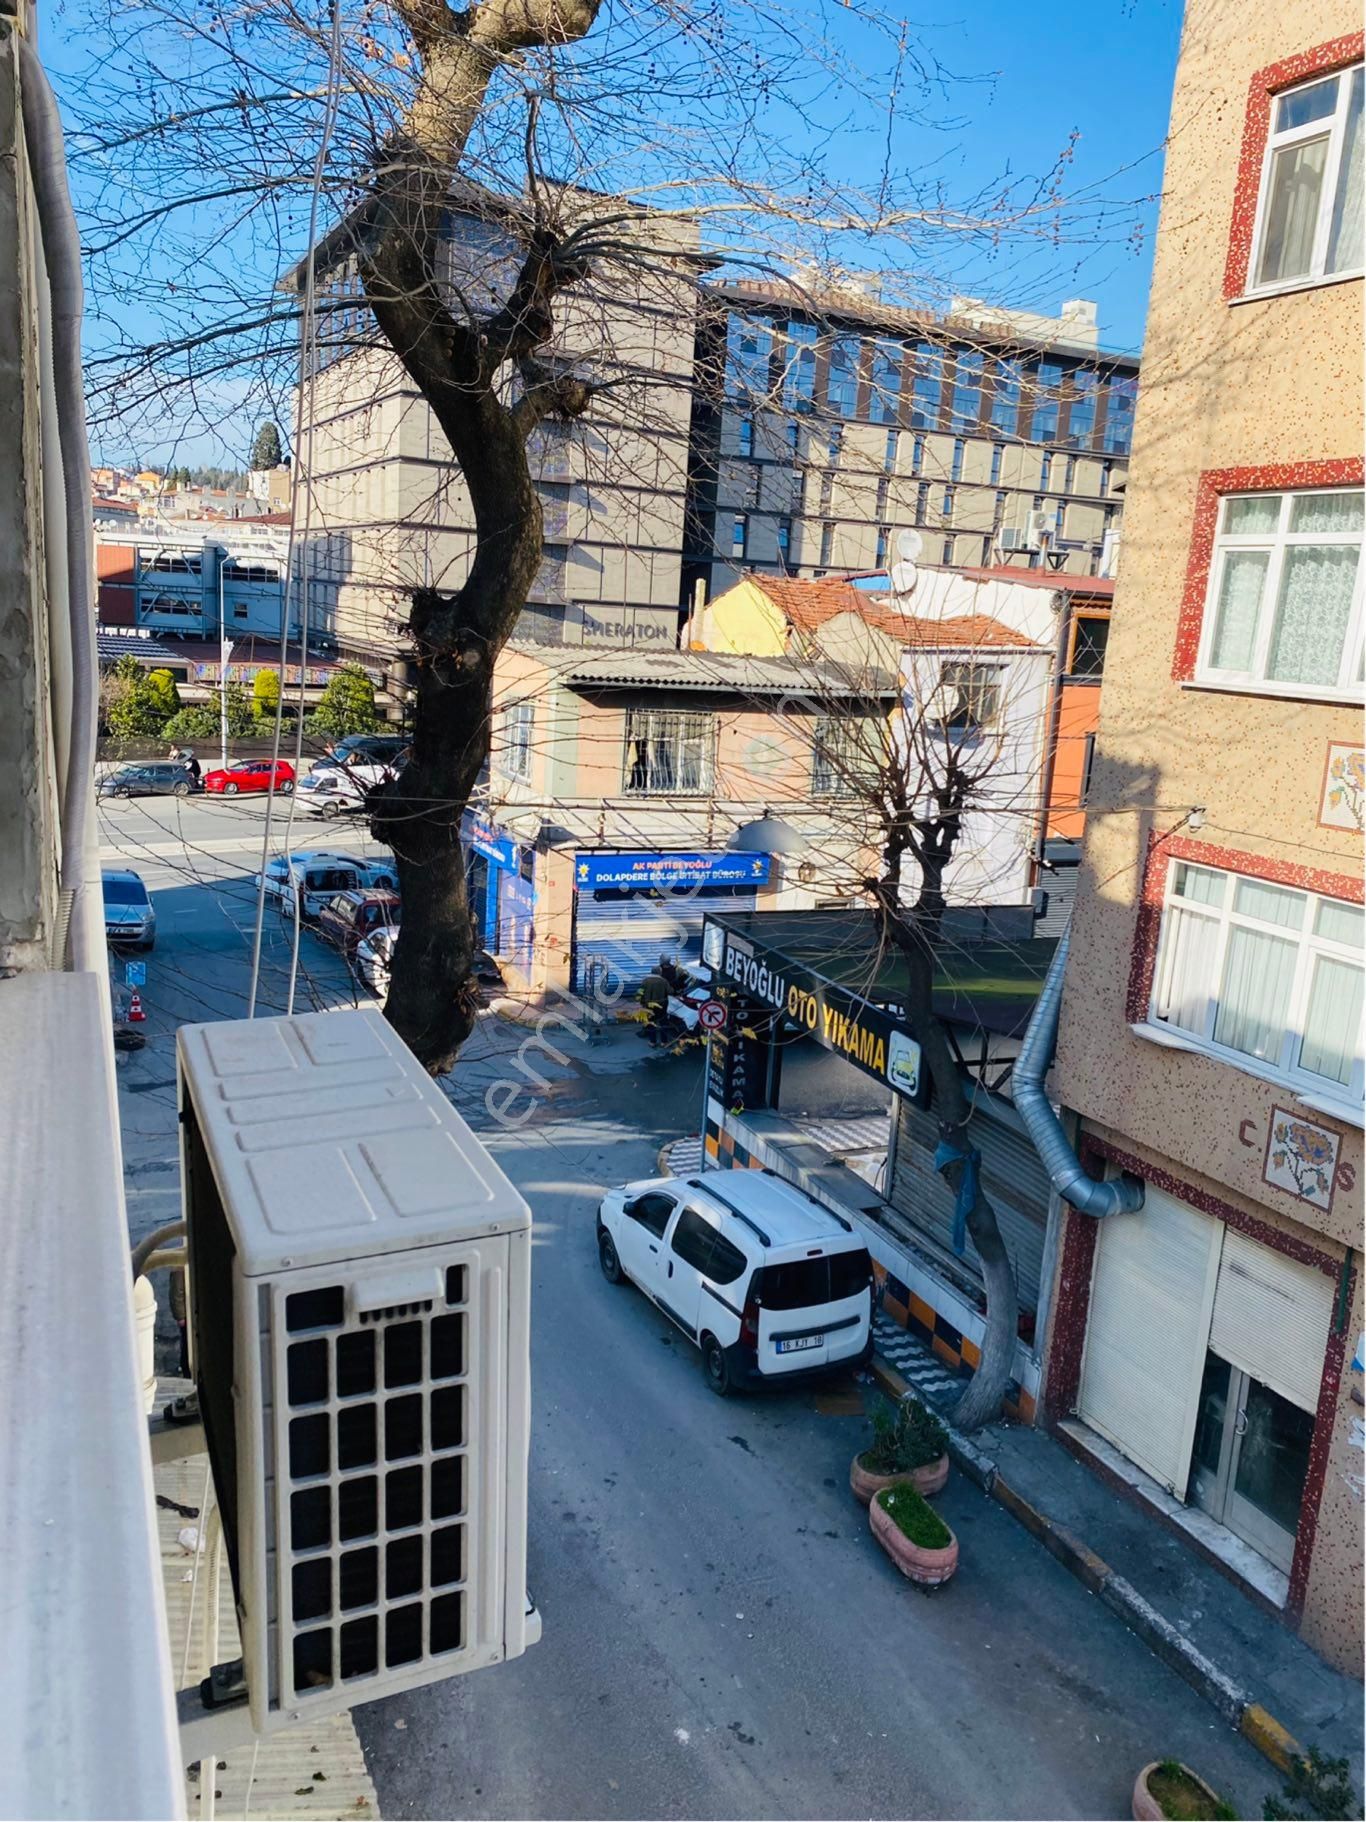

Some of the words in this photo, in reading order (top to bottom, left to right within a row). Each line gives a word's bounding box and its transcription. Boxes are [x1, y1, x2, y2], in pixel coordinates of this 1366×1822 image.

[583, 619, 669, 640] SHERATON
[596, 873, 648, 882] DOLAPDERE
[633, 861, 645, 870] AK
[726, 947, 785, 1009] BEYOĞLU
[787, 984, 818, 1030] OTO
[821, 1002, 886, 1076] YIKAMA
[731, 1031, 748, 1099] IKAMA
[1338, 1161, 1357, 1192] S
